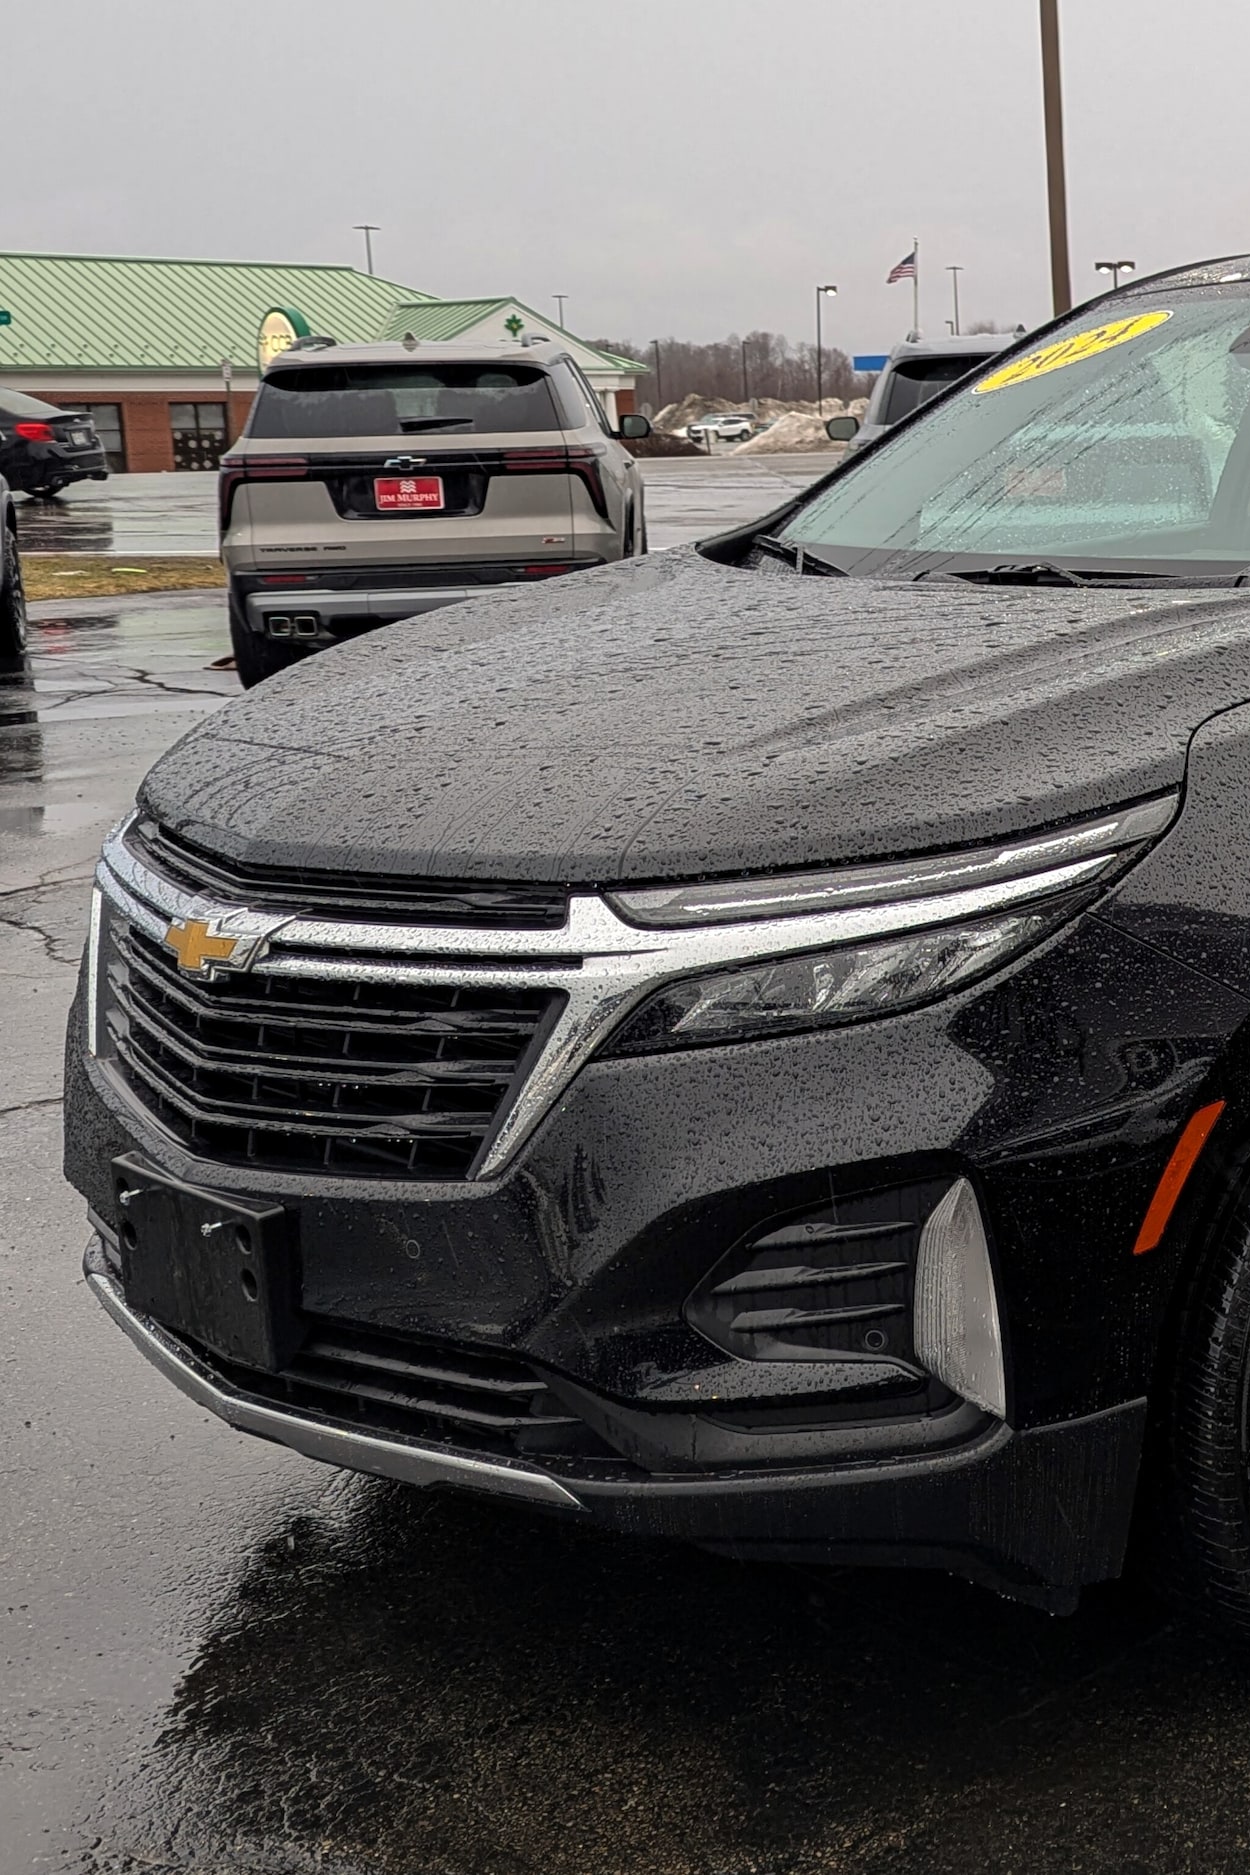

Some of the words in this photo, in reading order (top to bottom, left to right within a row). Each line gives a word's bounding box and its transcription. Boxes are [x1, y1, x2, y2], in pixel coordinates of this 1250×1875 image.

[1002, 317, 1144, 384] 2024
[380, 494, 395, 504] JIM
[397, 493, 438, 502] MURPHY
